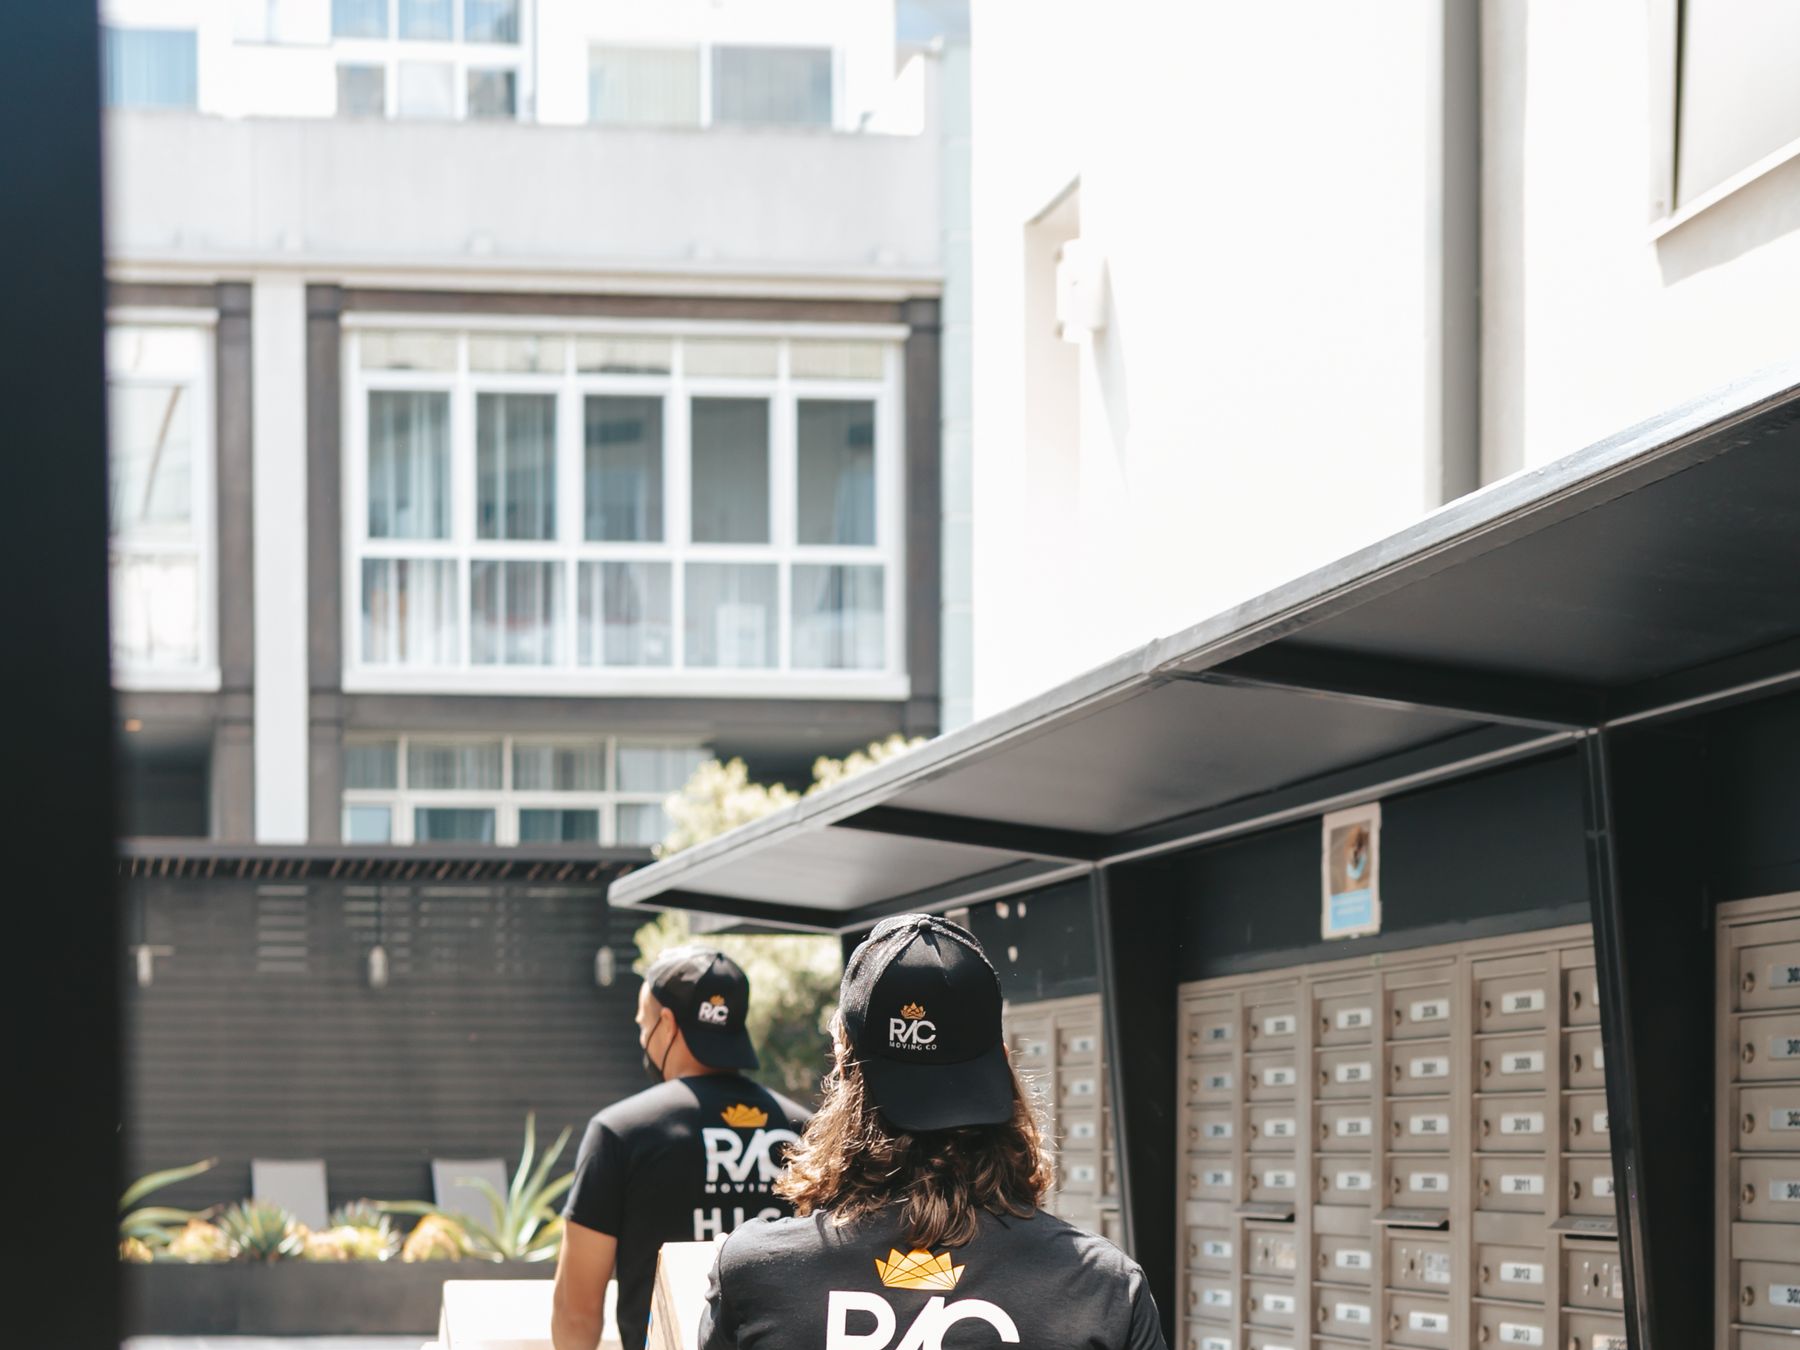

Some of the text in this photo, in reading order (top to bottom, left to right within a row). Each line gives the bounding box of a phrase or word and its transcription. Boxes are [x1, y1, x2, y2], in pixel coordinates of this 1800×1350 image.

[889, 1041, 923, 1051] MOVING
[705, 1183, 774, 1194] MOVIN
[1513, 1266, 1531, 1281] 3012
[1513, 1328, 1530, 1342] 3013
